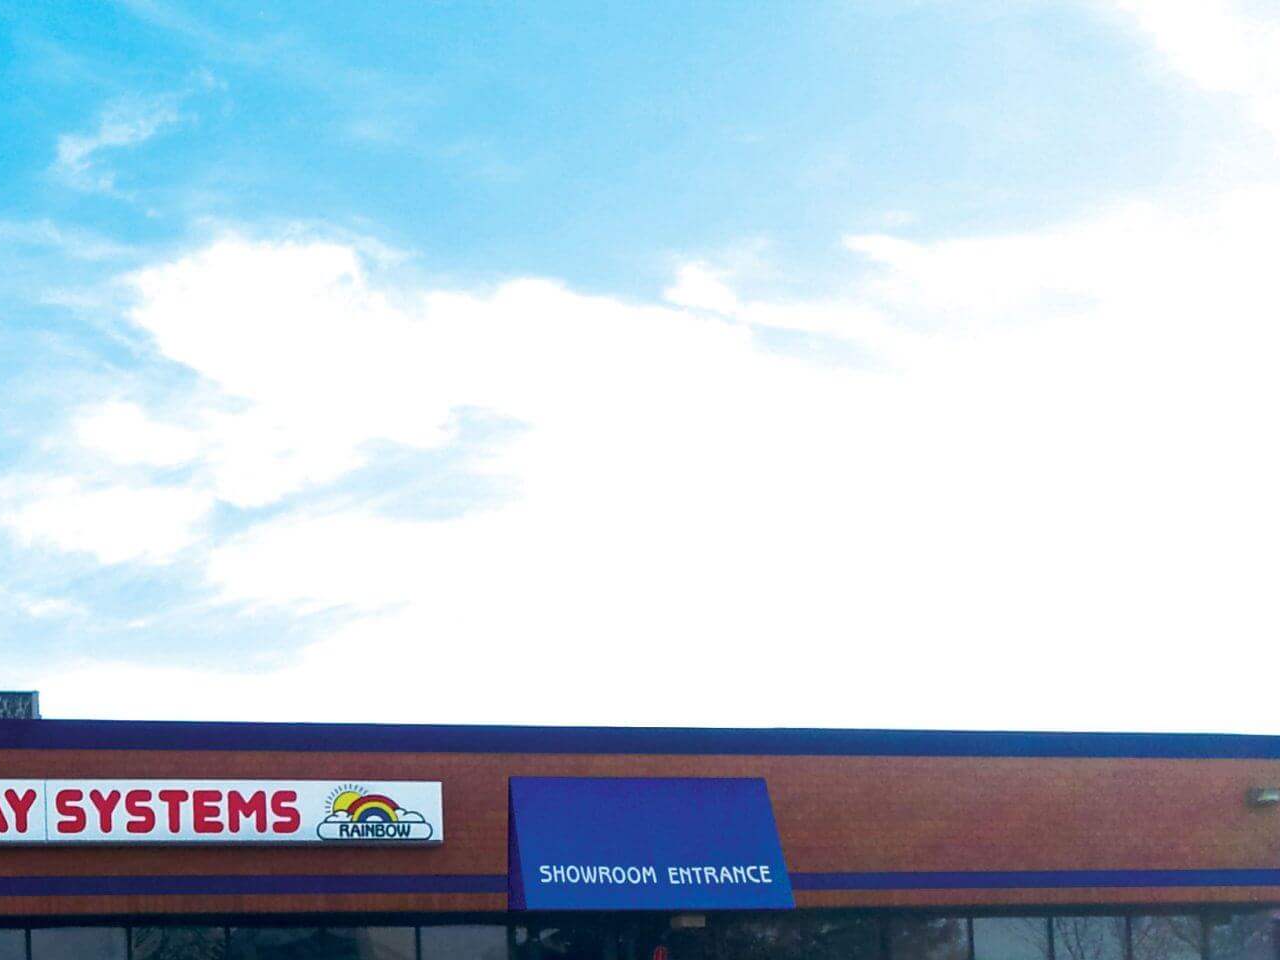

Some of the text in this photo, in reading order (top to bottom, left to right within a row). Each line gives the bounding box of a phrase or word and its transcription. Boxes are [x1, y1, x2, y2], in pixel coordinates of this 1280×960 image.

[55, 789, 301, 834] SYSTEMS
[339, 823, 411, 837] RAINBOW
[538, 864, 772, 884] SHOWROOM ENTRANCE
